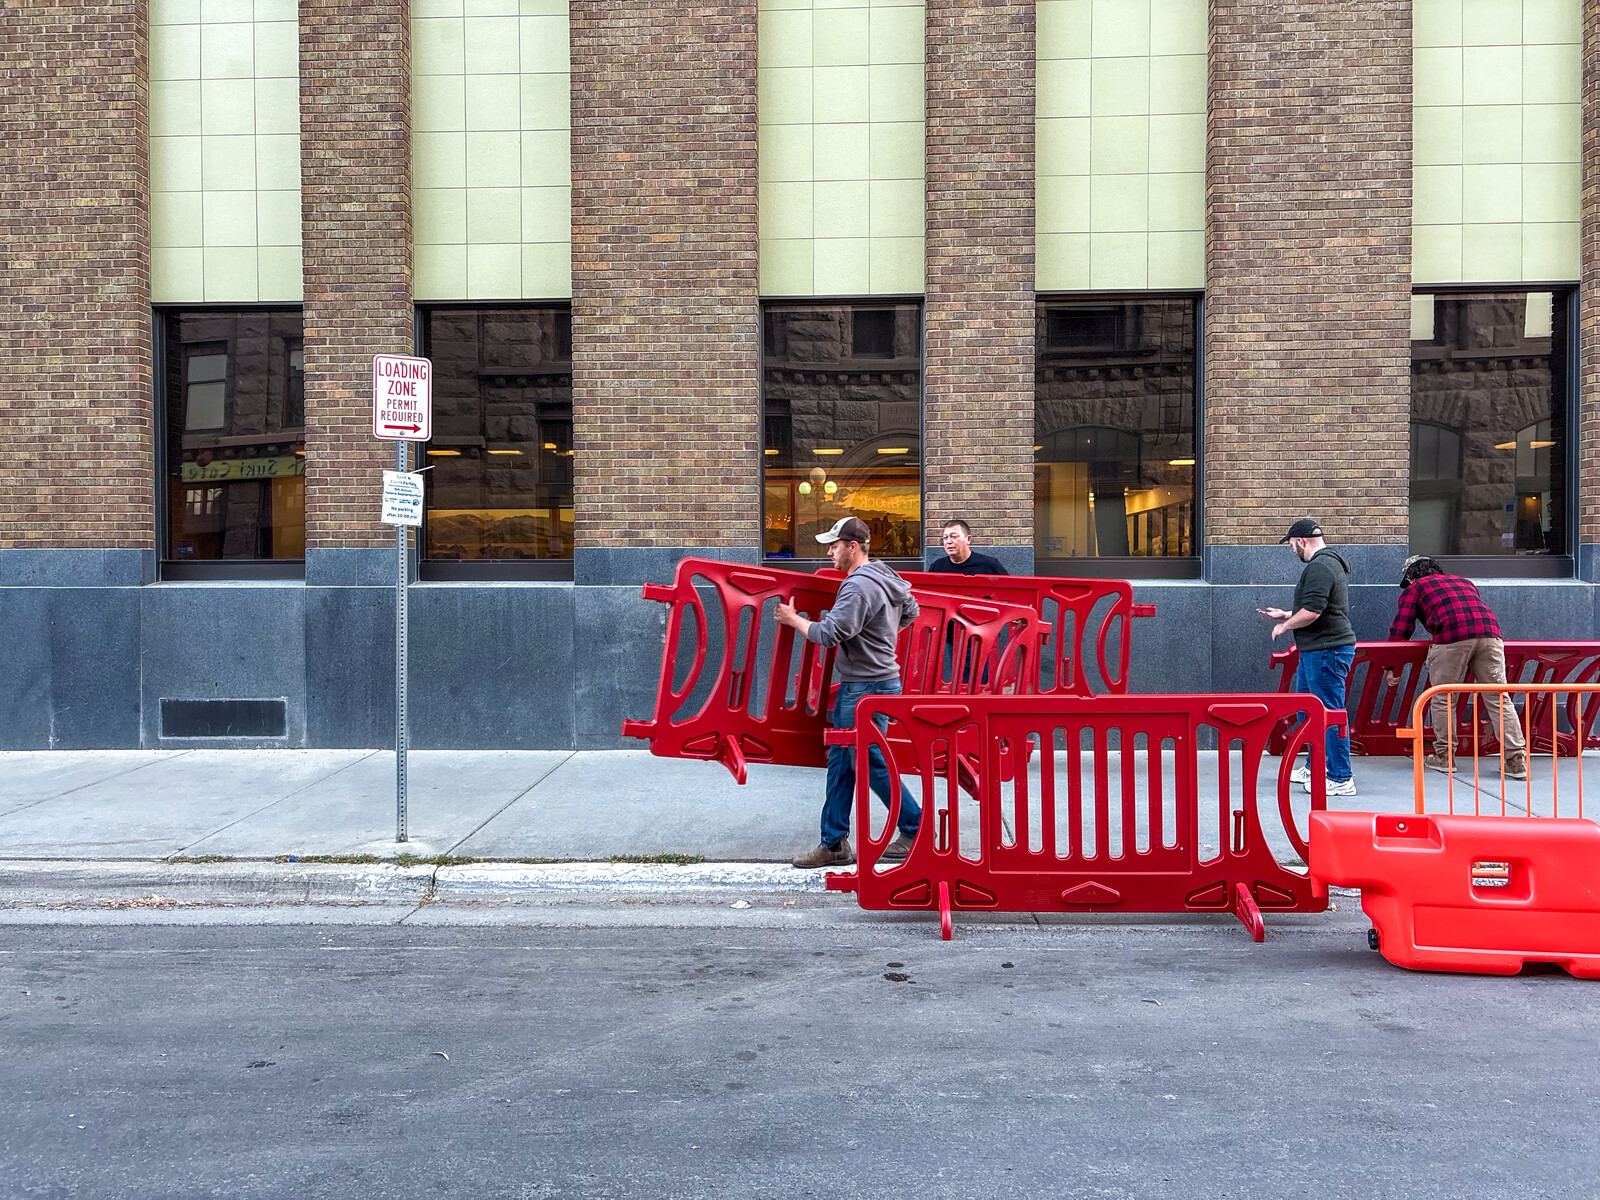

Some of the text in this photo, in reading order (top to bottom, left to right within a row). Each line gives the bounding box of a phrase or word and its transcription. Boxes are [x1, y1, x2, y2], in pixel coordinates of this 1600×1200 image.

[378, 361, 427, 380] LOADING
[388, 380, 417, 397] ZONE
[386, 399, 418, 411] PERMIT
[380, 410, 424, 423] REQUIRED
